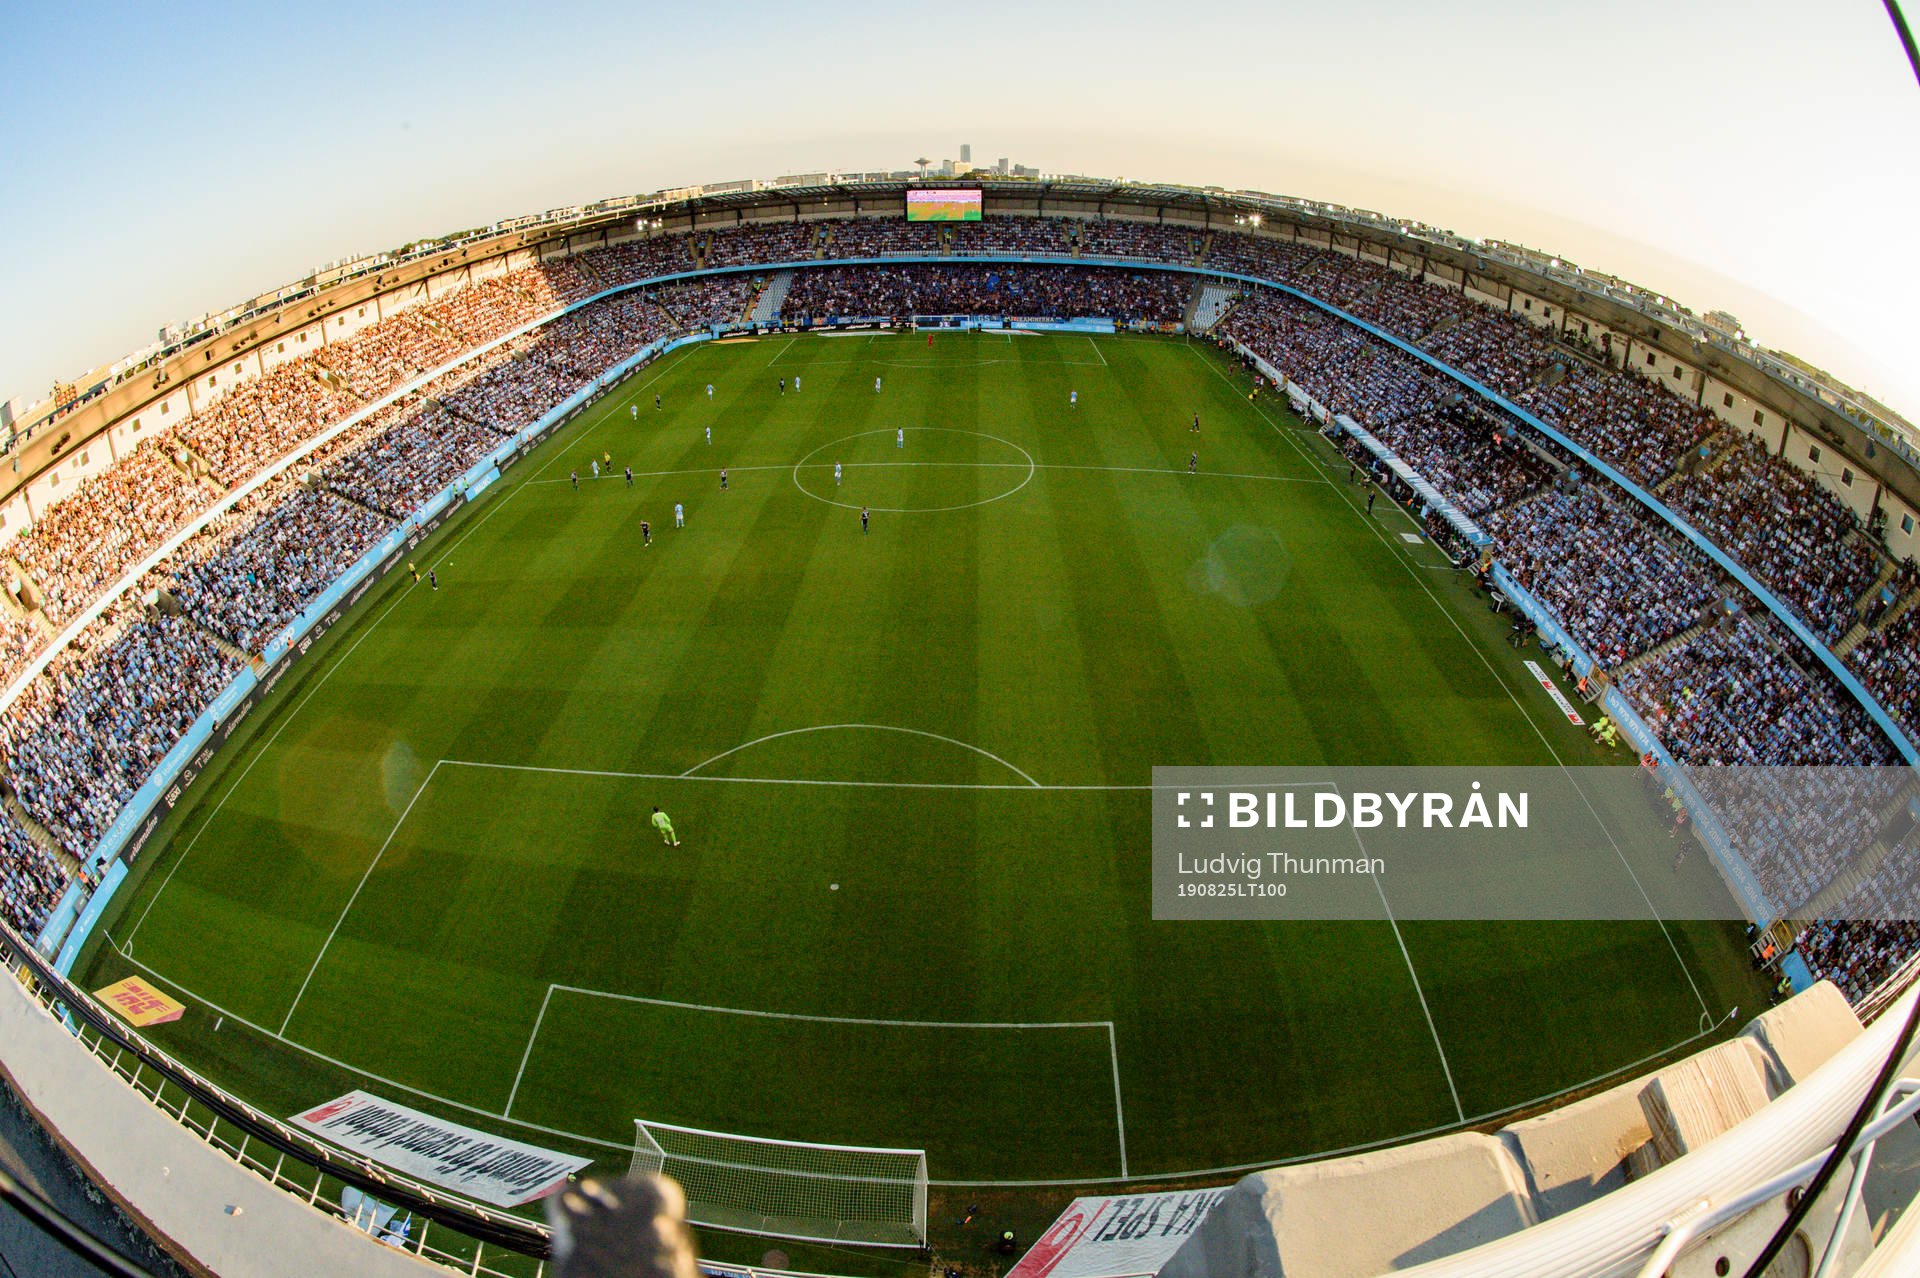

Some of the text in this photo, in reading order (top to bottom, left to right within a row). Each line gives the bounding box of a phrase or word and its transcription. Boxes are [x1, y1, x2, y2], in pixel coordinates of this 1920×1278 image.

[1709, 827, 1721, 846] 2010
[322, 1104, 573, 1195] Framåt för svensk fotboll
[1092, 1195, 1175, 1241] SPEL
